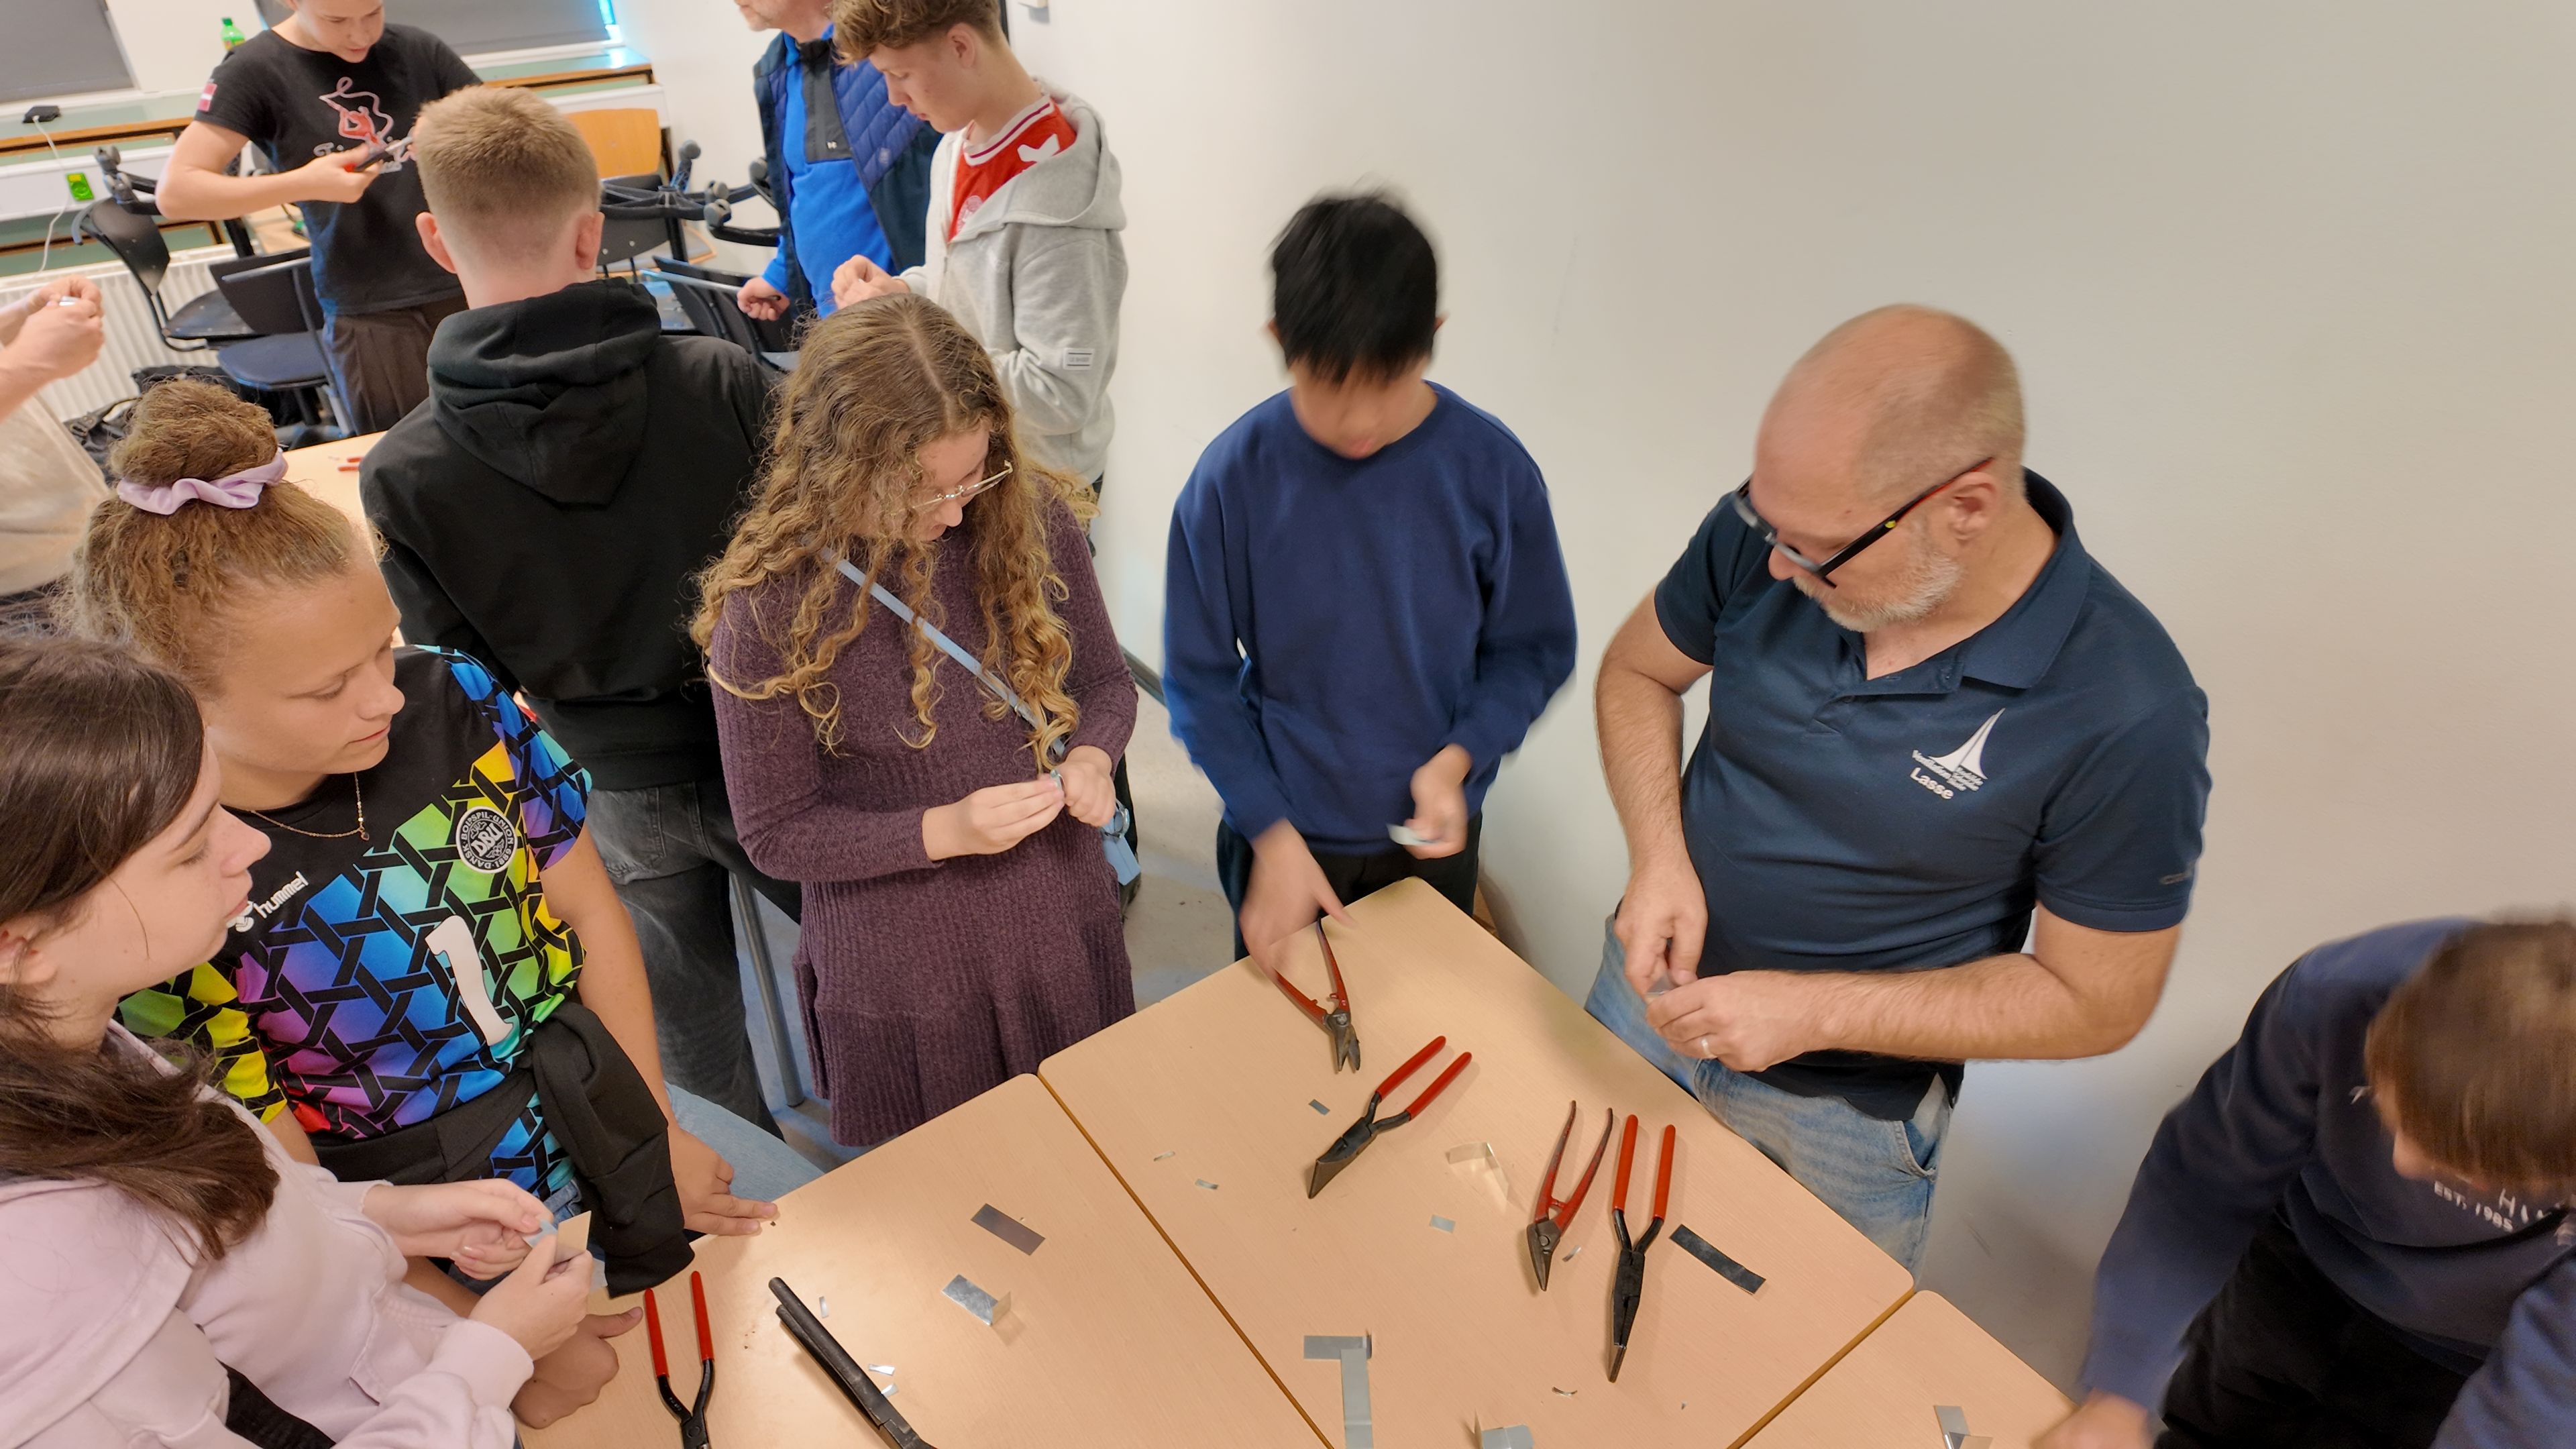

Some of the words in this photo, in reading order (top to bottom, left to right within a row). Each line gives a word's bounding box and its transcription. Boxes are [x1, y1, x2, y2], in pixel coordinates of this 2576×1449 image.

[1910, 767, 1954, 800] Lasse
[462, 844, 492, 869] DANSK
[470, 822, 503, 857] DBU
[253, 871, 309, 918] hummel
[425, 914, 514, 1046] 1
[2475, 1203, 2513, 1232] 1985
